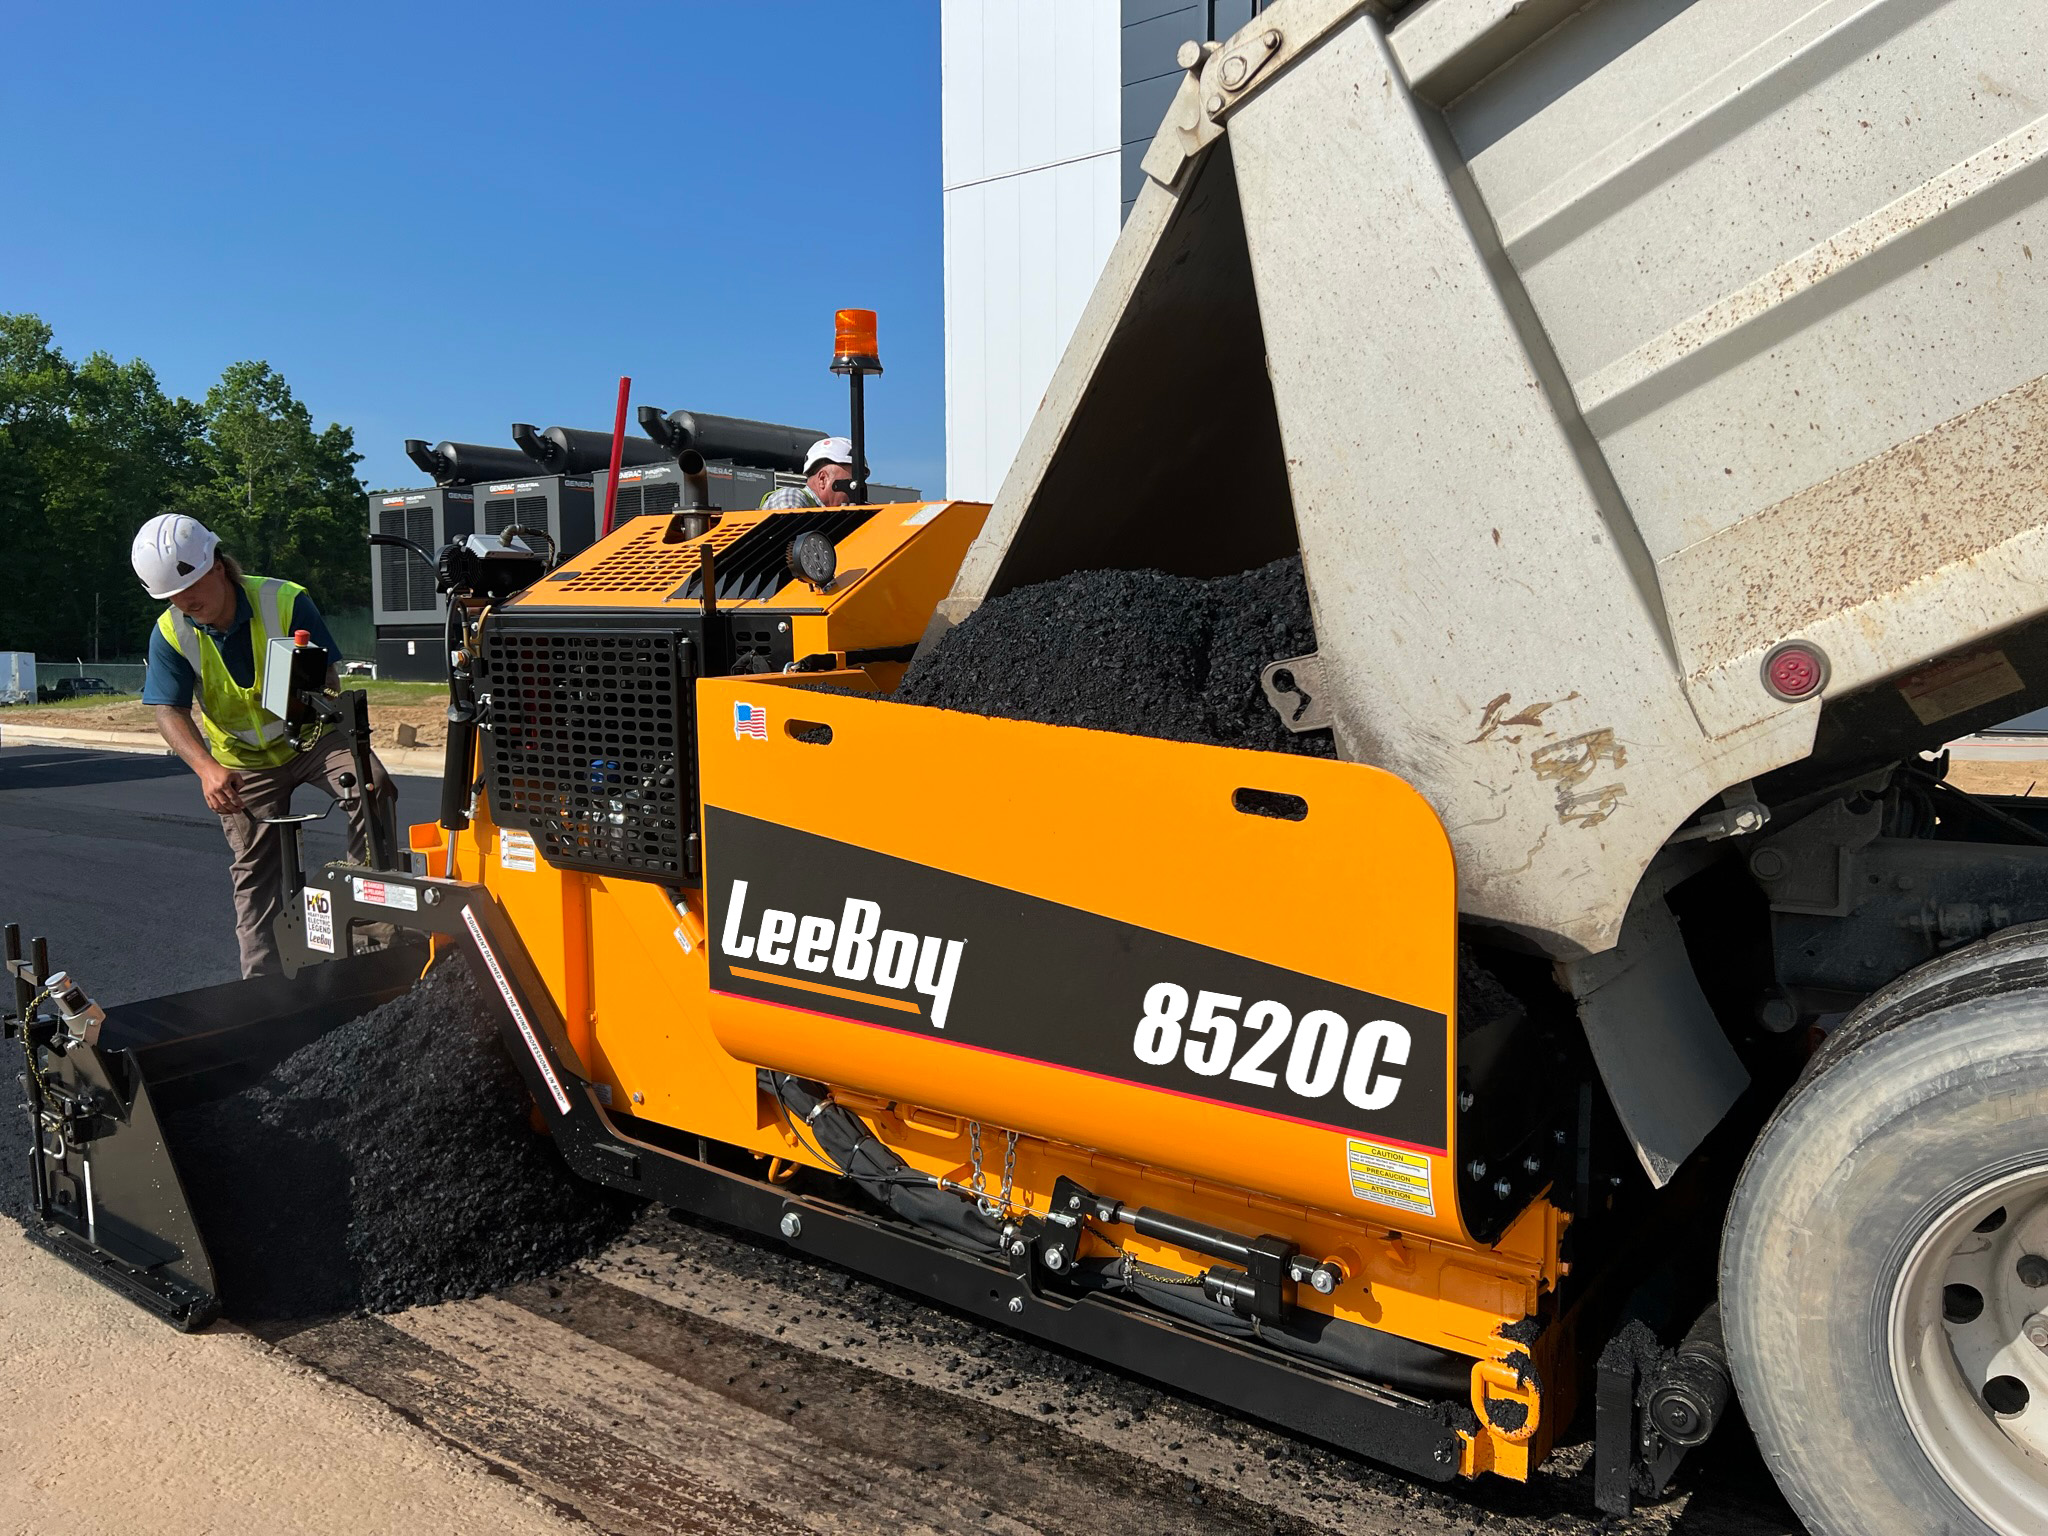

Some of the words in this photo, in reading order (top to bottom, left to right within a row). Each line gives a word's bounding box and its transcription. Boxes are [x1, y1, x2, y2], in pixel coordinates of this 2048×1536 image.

[619, 469, 642, 479] ENERAC
[706, 466, 733, 476] NERAC
[489, 484, 515, 492] GENERAC
[565, 480, 594, 488] GENERA
[448, 492, 473, 500] GENER
[308, 917, 331, 927] ELECTRIC
[308, 923, 332, 935] LEGEND
[309, 932, 333, 950] LeeBoy
[721, 879, 965, 1029] LeeBoy
[484, 949, 503, 980] DESIGNED
[500, 979, 511, 996] WITH
[507, 995, 517, 1008] THE
[514, 1008, 528, 1031] PAVING
[525, 1031, 549, 1077] PROFESSIONAL
[548, 1076, 556, 1084] IN
[1133, 982, 1412, 1111] 8520C
[1371, 1148, 1404, 1162] CAUTION
[1366, 1167, 1411, 1182] PRECAUCION
[1371, 1185, 1411, 1199] ATTENTION
